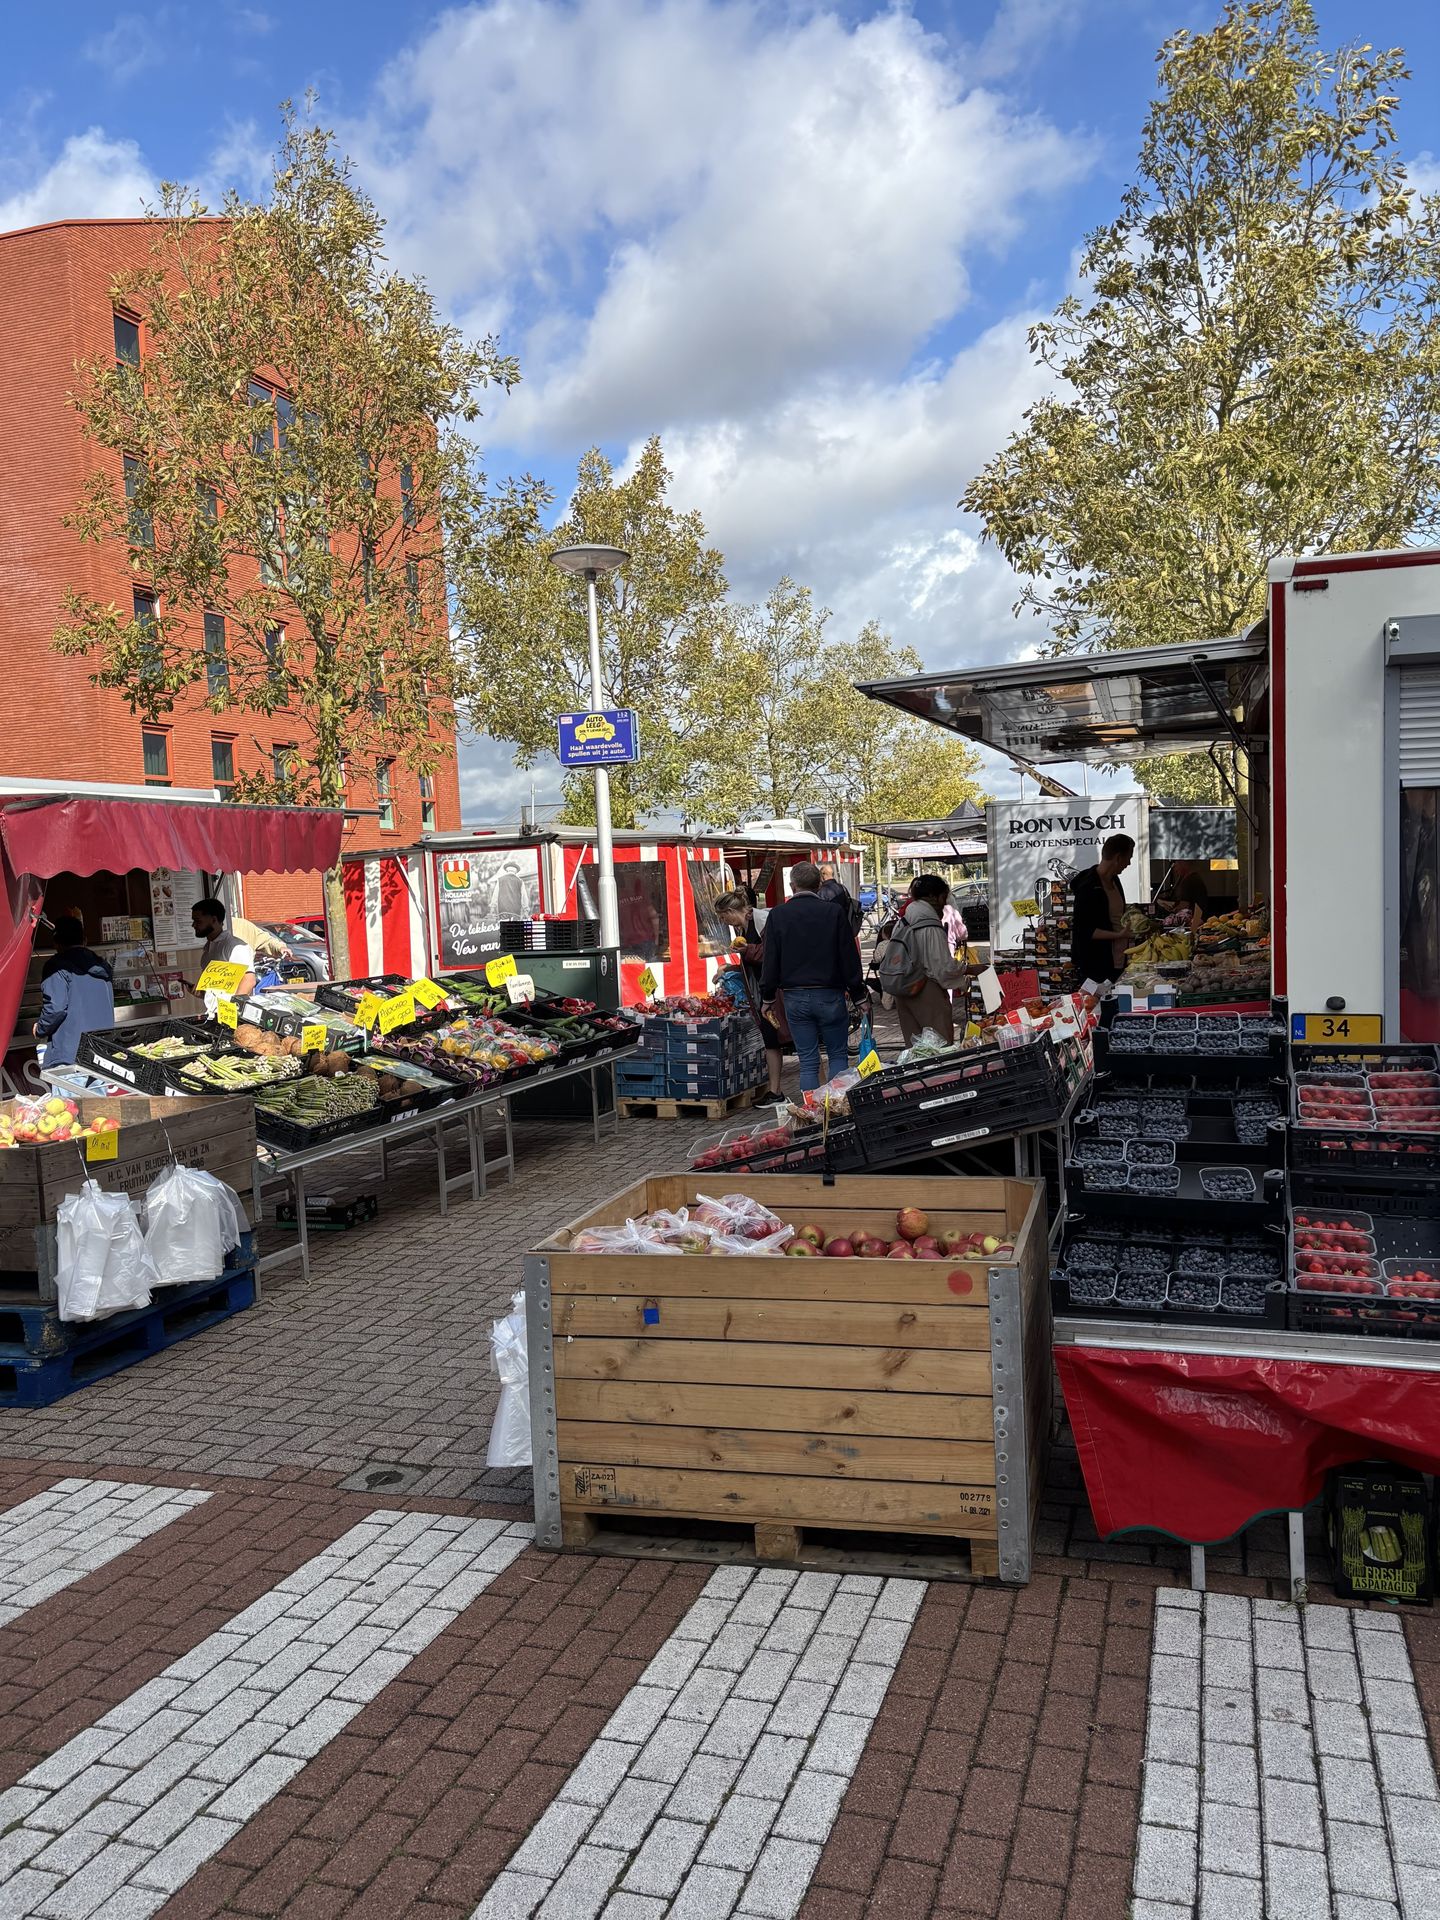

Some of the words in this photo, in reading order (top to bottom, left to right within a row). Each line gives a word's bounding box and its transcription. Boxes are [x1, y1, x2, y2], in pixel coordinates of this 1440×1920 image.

[568, 750, 590, 758] spullen
[586, 742, 623, 750] waardevolle
[1009, 818, 1053, 834] RON
[1057, 814, 1126, 832] VISCH
[1009, 840, 1024, 849] DE
[1025, 837, 1106, 848] NOTENSPECIAL
[449, 923, 467, 938] De
[468, 921, 501, 935] lekkers
[451, 939, 478, 956] Vers
[480, 941, 501, 953] van
[1322, 1018, 1350, 1037] 34
[125, 1163, 141, 1177] VAN
[201, 1143, 210, 1154] ZN
[960, 1492, 991, 1502] 002778
[1365, 1565, 1403, 1582] FRESH
[1355, 1577, 1414, 1593] ASPARAGUS
